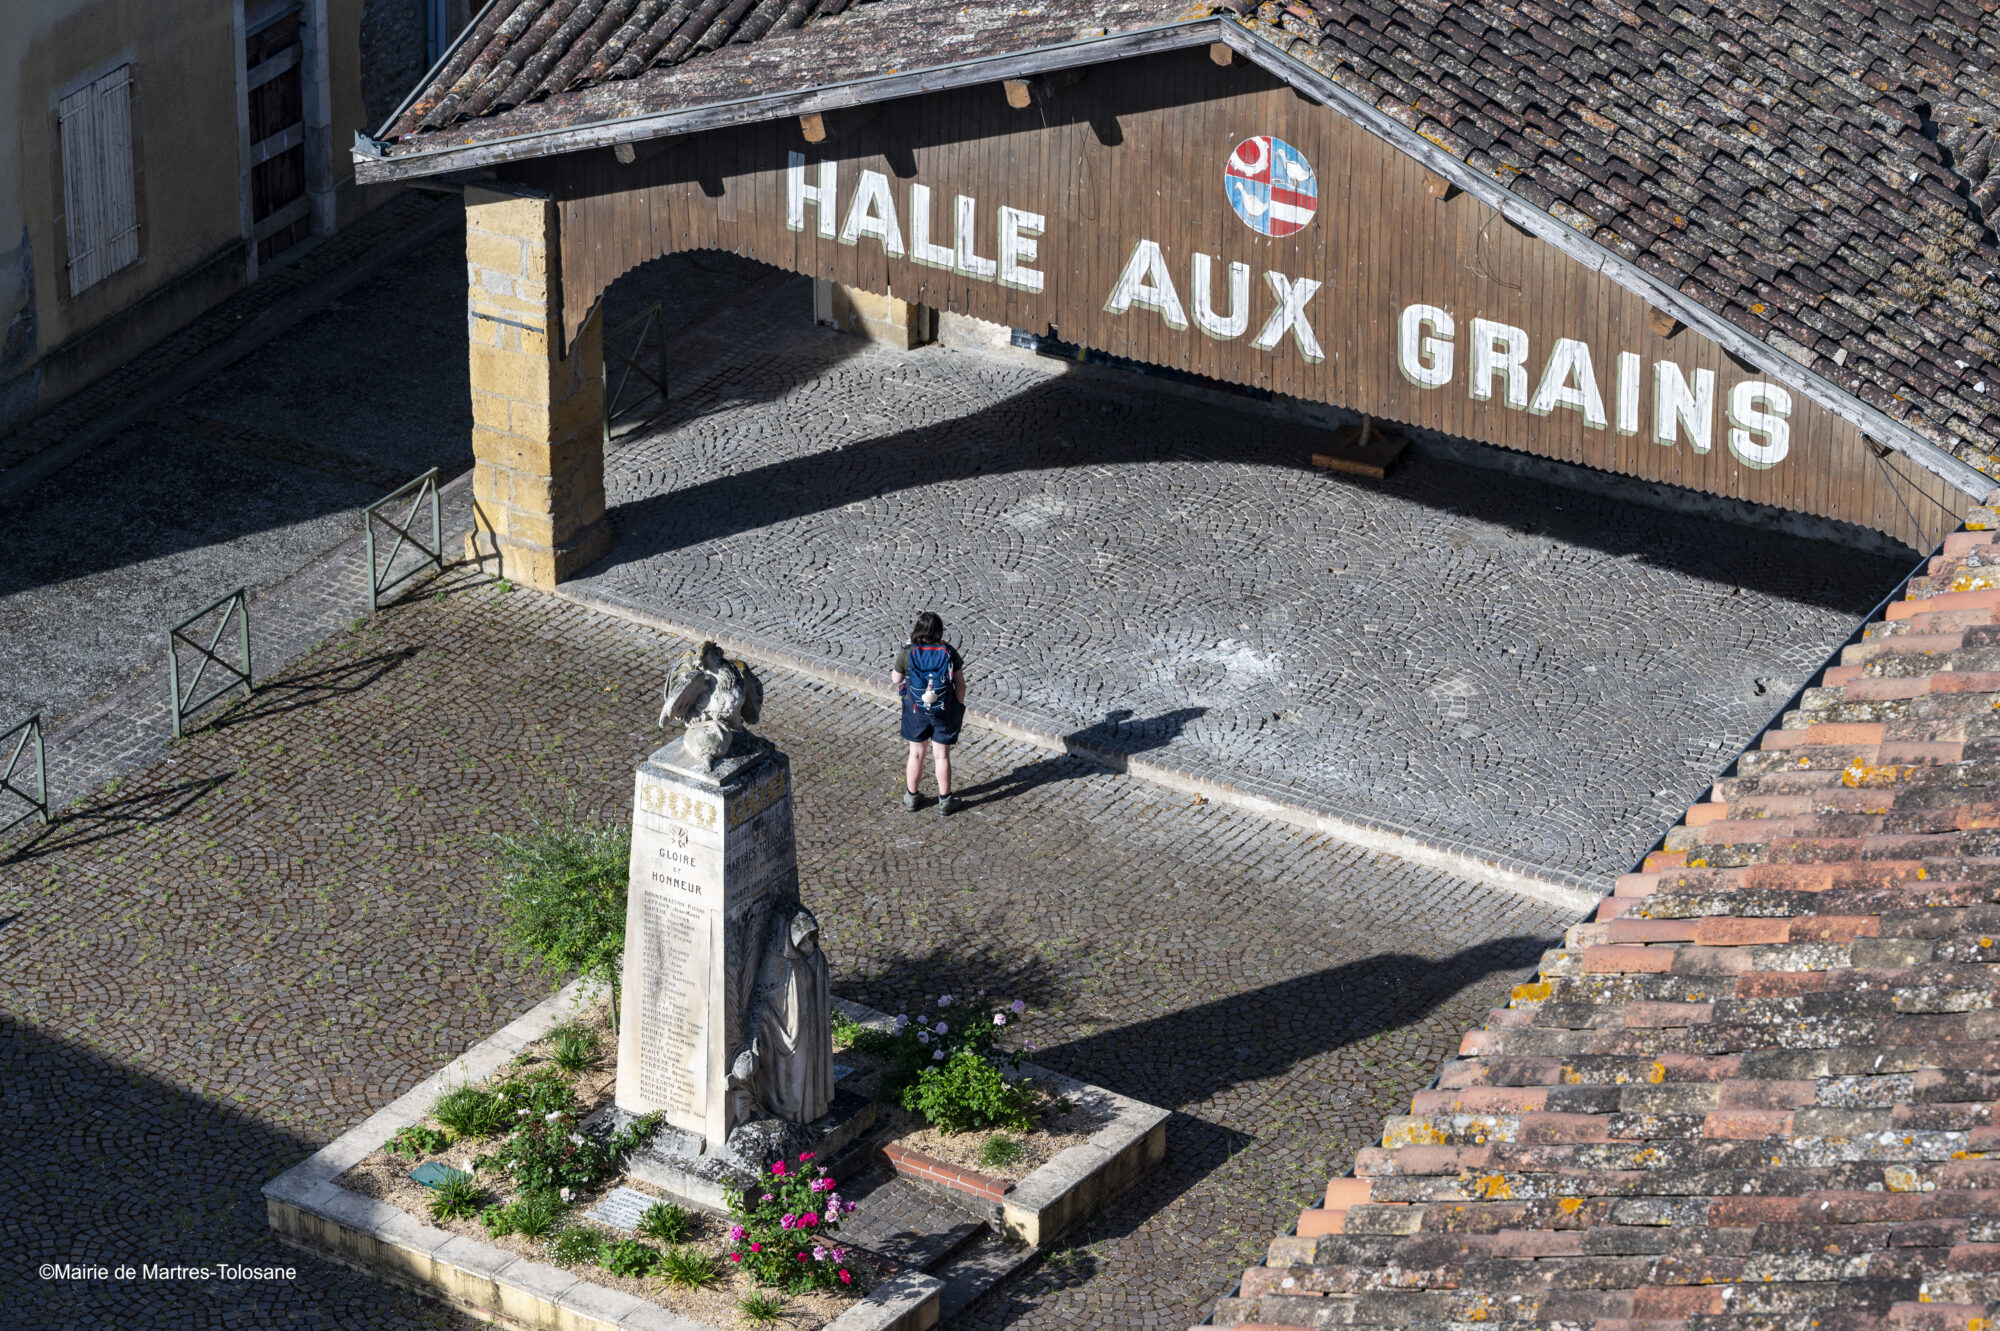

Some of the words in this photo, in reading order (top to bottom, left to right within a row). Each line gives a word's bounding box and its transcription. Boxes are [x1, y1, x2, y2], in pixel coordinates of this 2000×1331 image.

[787, 151, 1045, 293] HALLE
[1104, 239, 1326, 363] AUX
[1398, 303, 1792, 470] GRAINS
[659, 848, 696, 867] GLOIRE
[652, 871, 702, 896] HONNEUR
